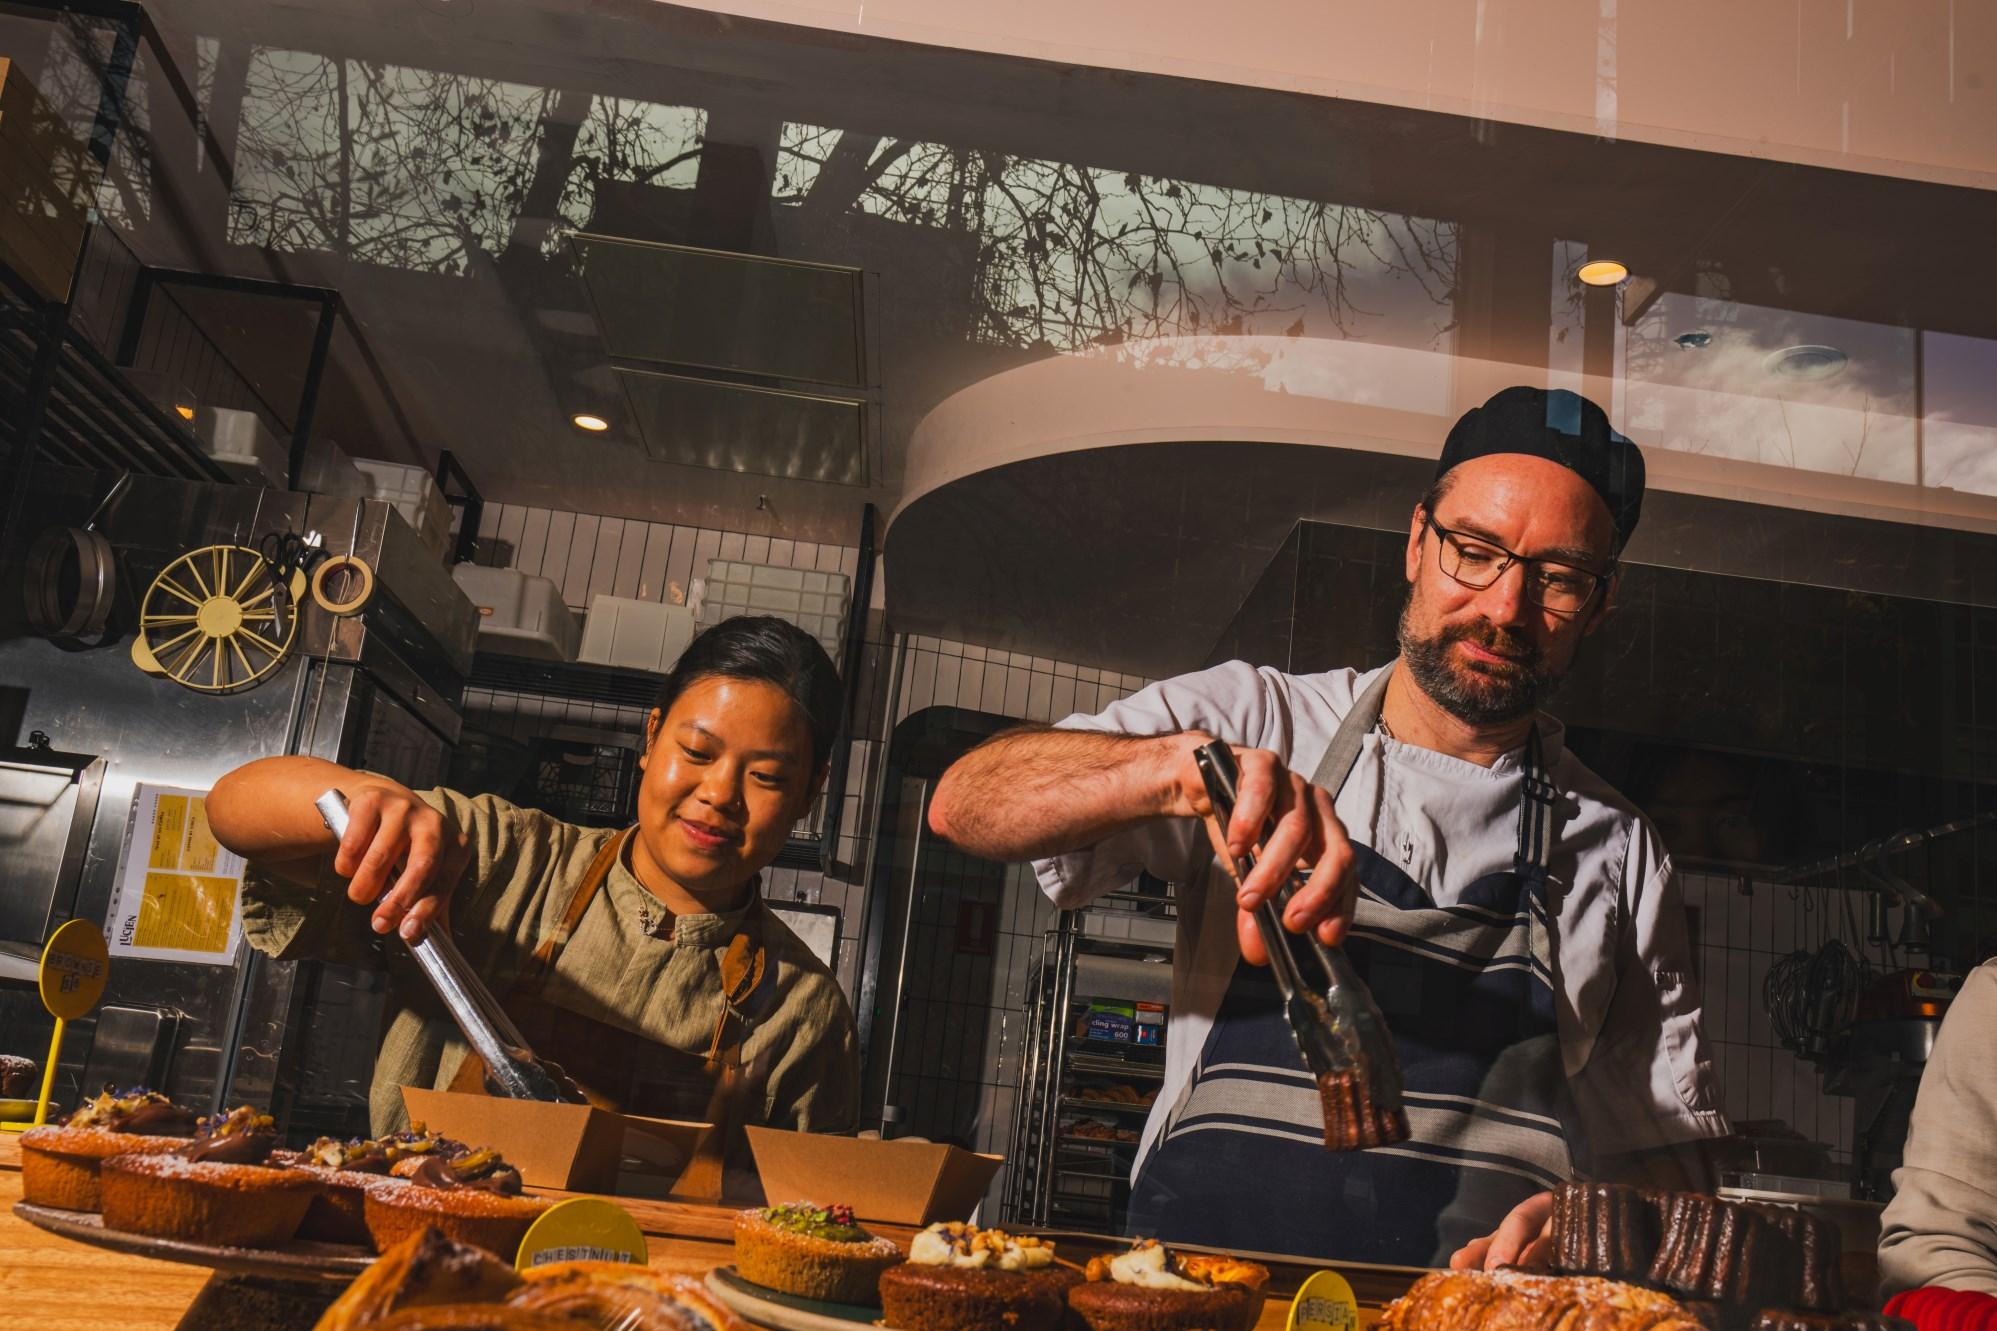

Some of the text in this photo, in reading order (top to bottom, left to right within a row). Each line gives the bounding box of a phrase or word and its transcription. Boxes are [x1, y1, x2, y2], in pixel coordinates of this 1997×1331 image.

[120, 915, 137, 946] LUCIEN
[1092, 1020, 1129, 1030] cling wrap
[1114, 1031, 1129, 1039] 600
